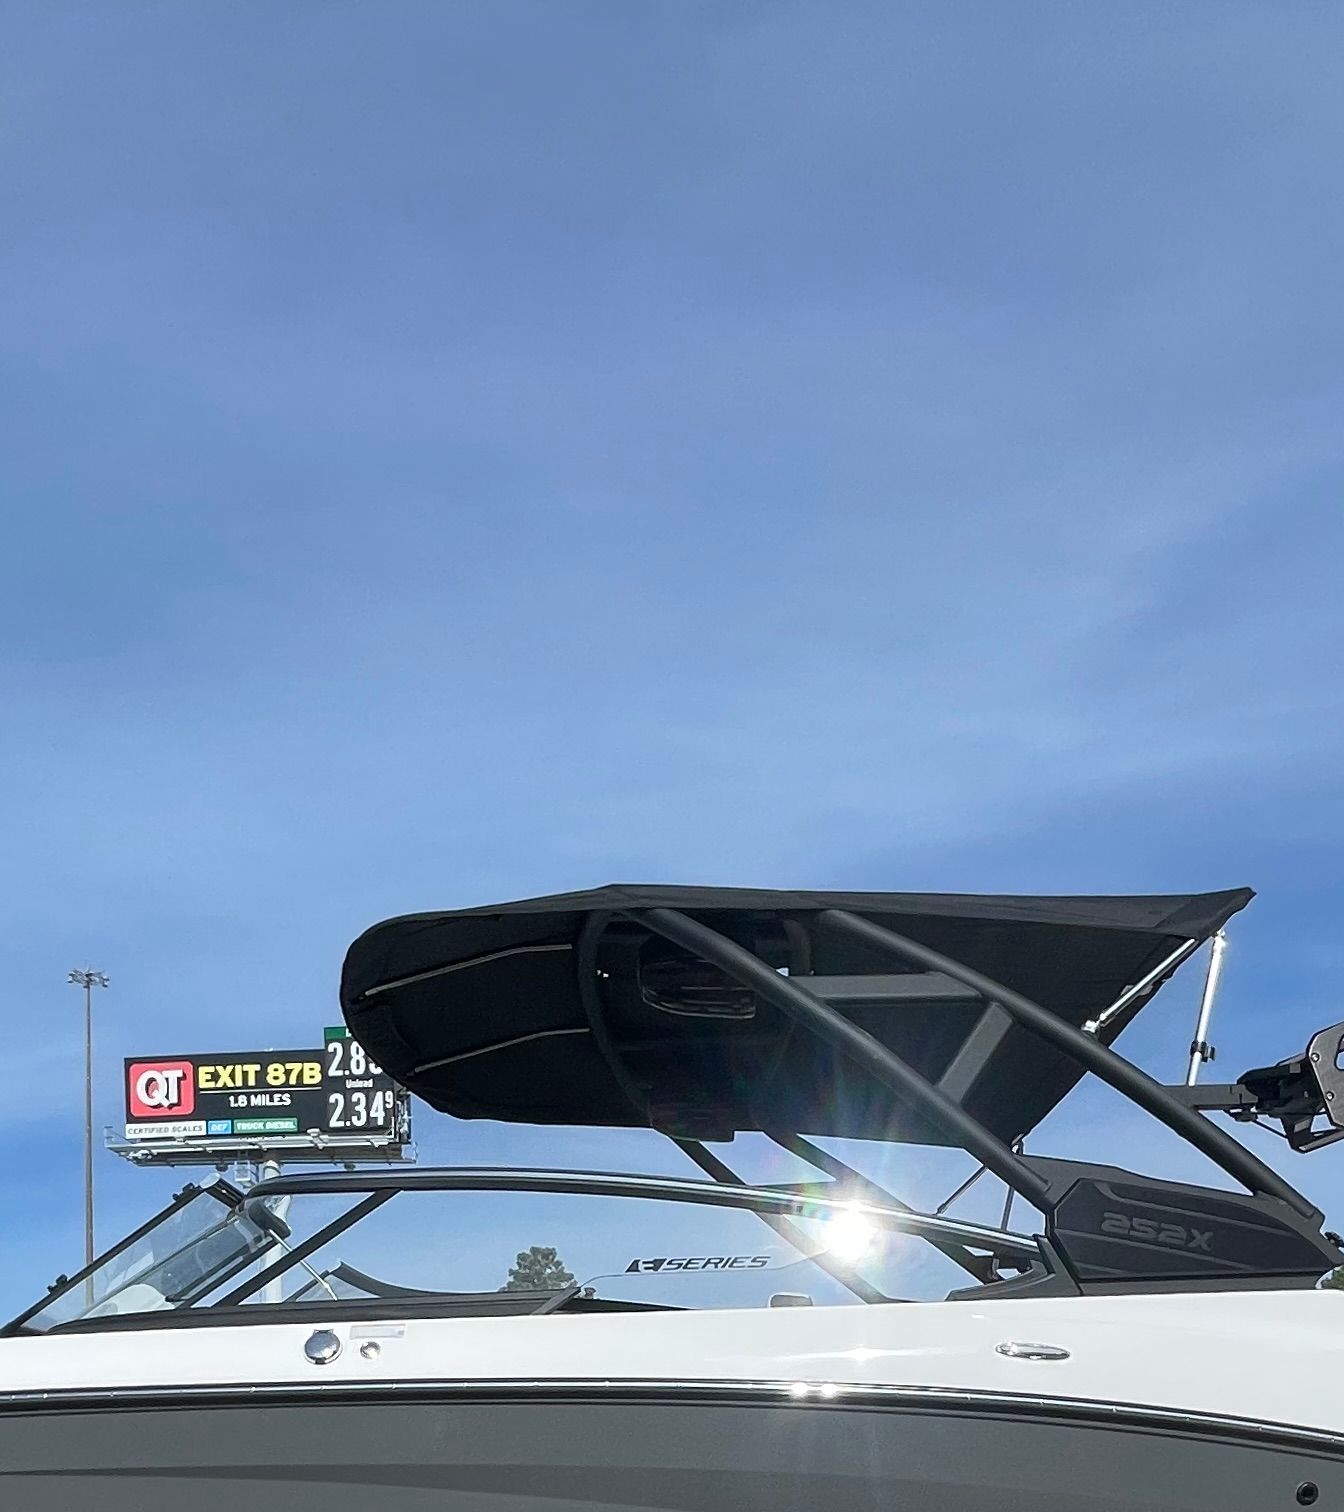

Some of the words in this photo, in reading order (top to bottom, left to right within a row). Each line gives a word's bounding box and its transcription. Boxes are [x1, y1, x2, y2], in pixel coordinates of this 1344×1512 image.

[197, 1064, 261, 1089] EXIT
[266, 1062, 322, 1087] 87B
[136, 1068, 185, 1108] QT
[229, 1095, 248, 1108] 1.8
[250, 1093, 292, 1107] MILES
[127, 1126, 169, 1135] CERTIFIED
[171, 1124, 203, 1133] SCALES
[236, 1121, 265, 1131] TRUCK
[265, 1120, 297, 1130] DIESEL
[1100, 1212, 1214, 1251] 252X
[662, 1256, 772, 1271] SERIES
